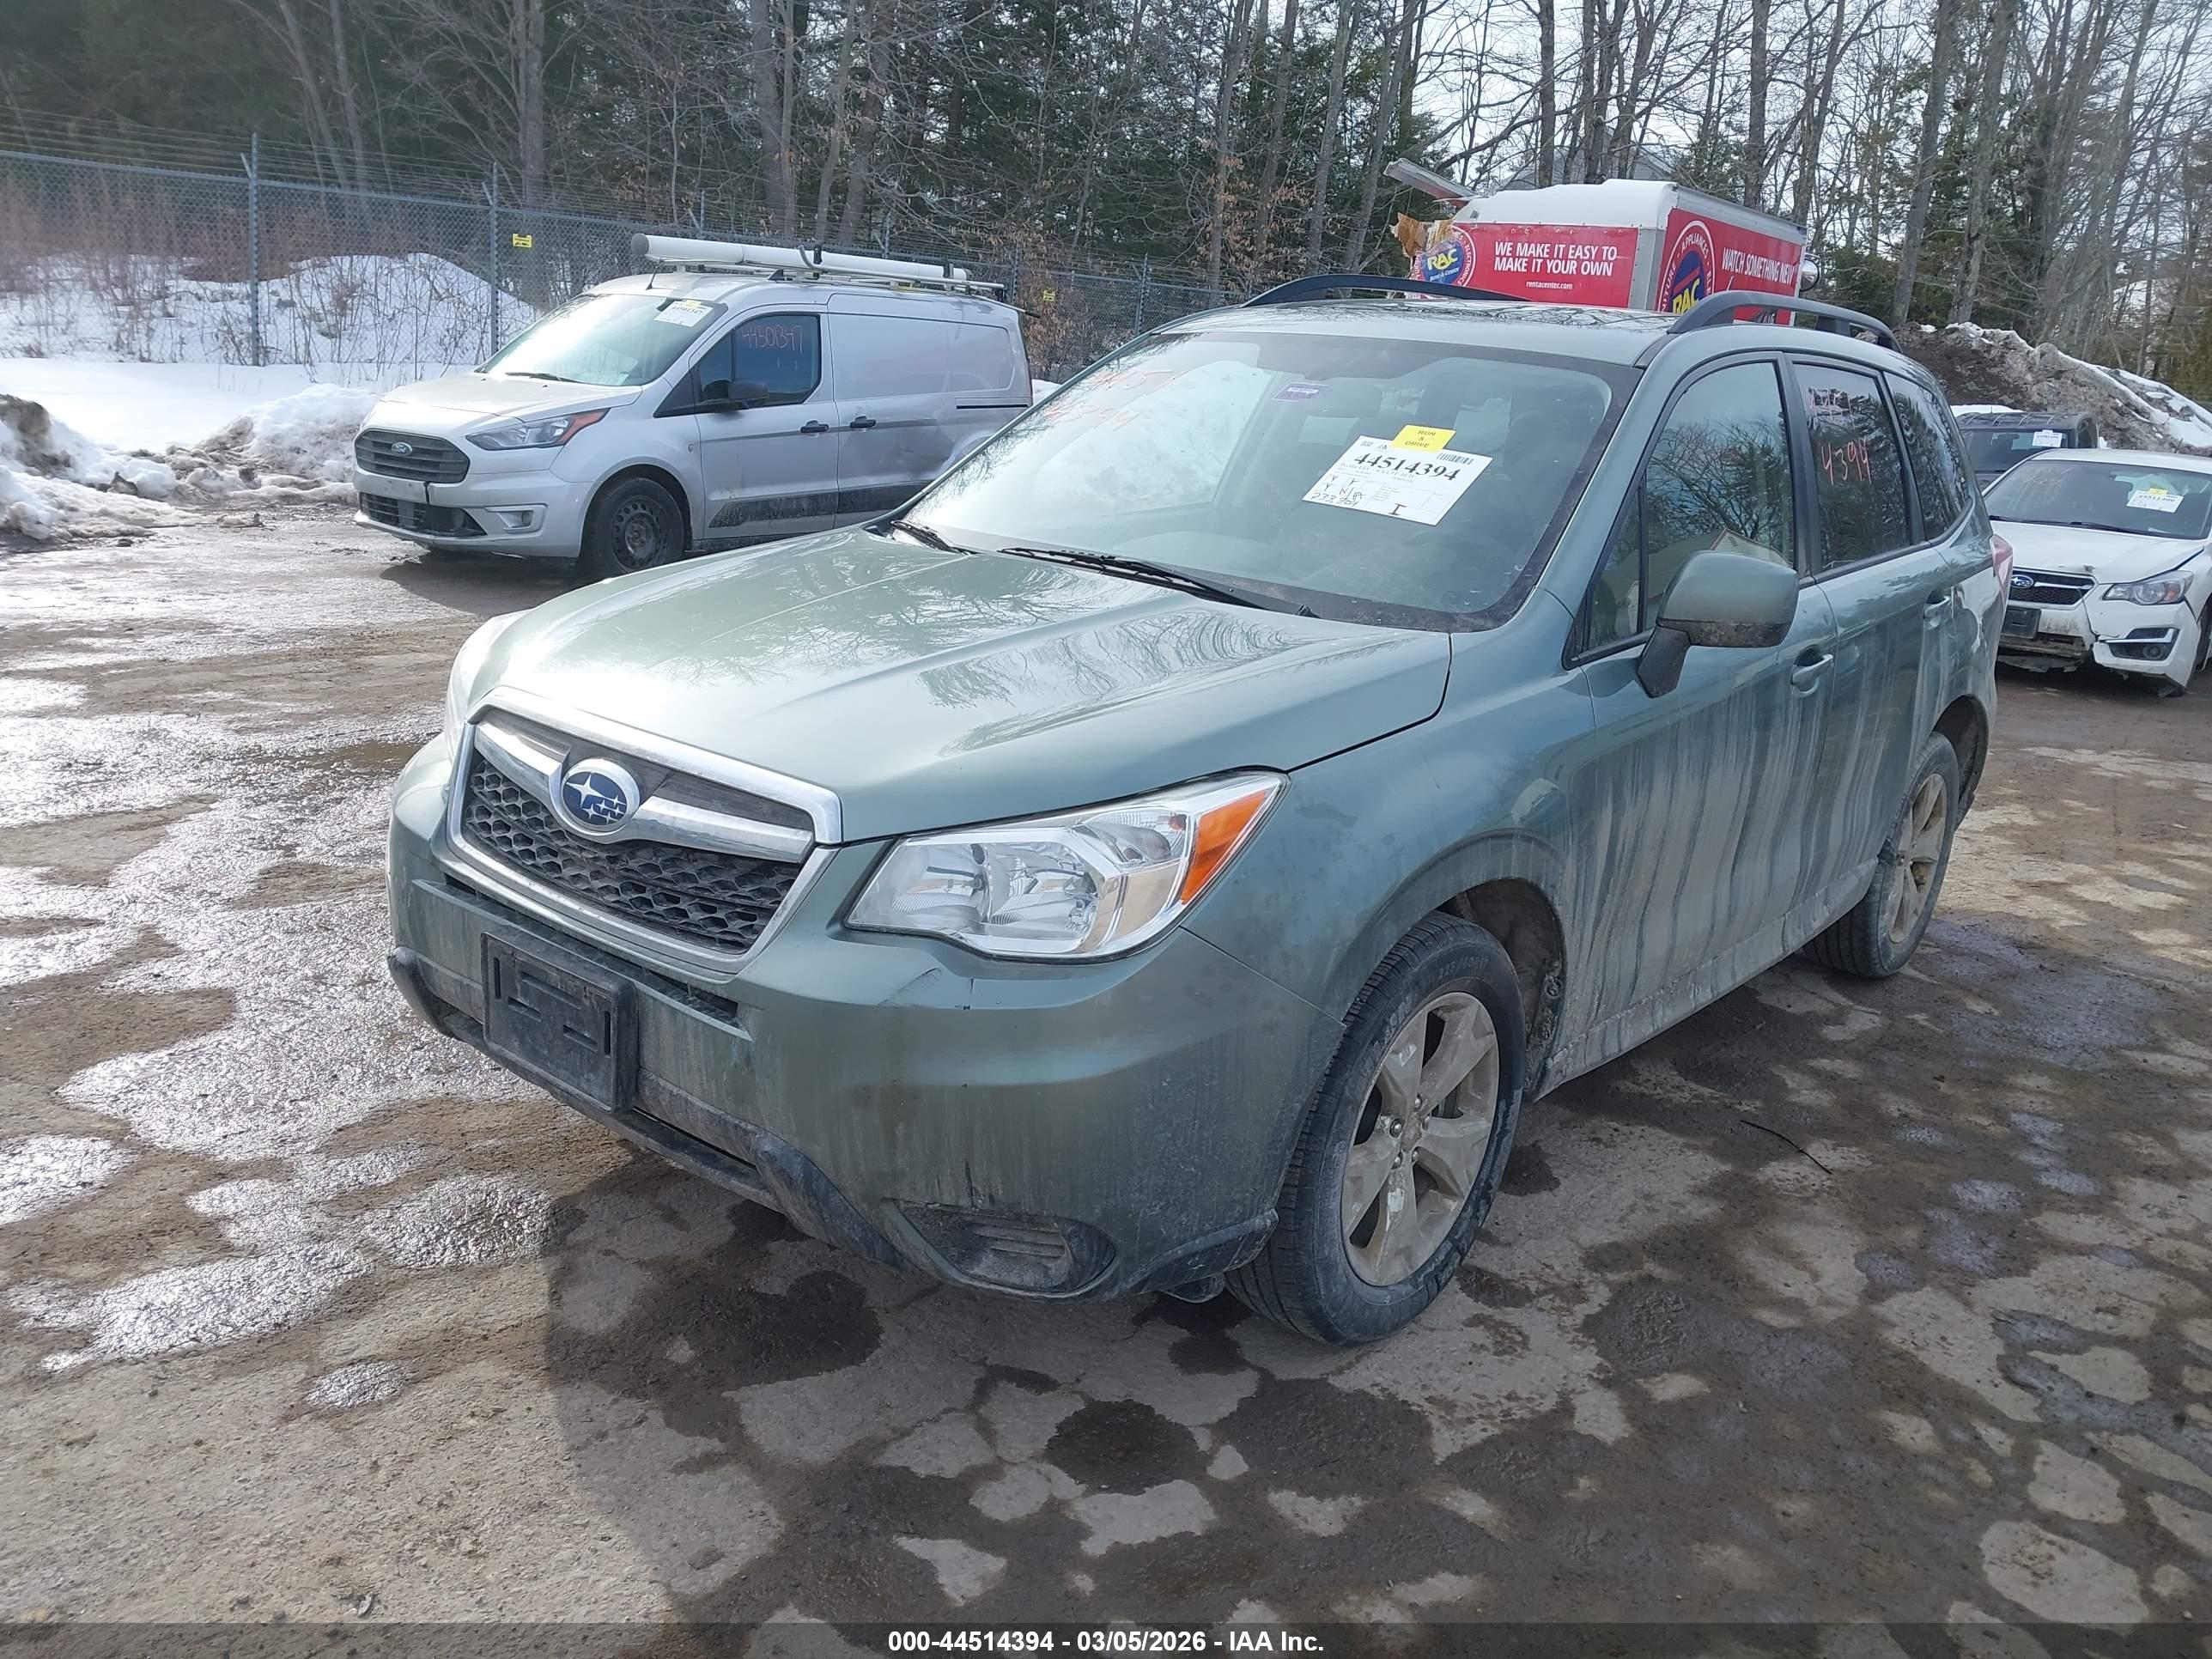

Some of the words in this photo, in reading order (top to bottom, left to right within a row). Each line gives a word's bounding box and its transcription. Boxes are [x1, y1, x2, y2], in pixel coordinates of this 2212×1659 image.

[1427, 248, 1458, 270] RAC
[1495, 241, 1513, 257] WE
[1516, 243, 1551, 258] MAKE
[1553, 244, 1566, 259] IT
[1568, 245, 1599, 260] EASY
[1601, 246, 1618, 261] TO
[1681, 233, 1709, 259] APPLIANCES
[1457, 244, 1472, 285] ELECTRONICS
[1493, 257, 1528, 273] MAKE
[1531, 258, 1544, 273] IT
[1547, 259, 1577, 275] YOUR
[1581, 261, 1614, 276] OWN
[1722, 247, 1746, 275] WATCH
[1745, 254, 1780, 282] SOMETHING
[1526, 281, 1573, 289] rentacenter.com
[1672, 277, 1700, 315] RAC
[1353, 453, 1462, 482] 44514394
[1821, 437, 1872, 485] 4394
